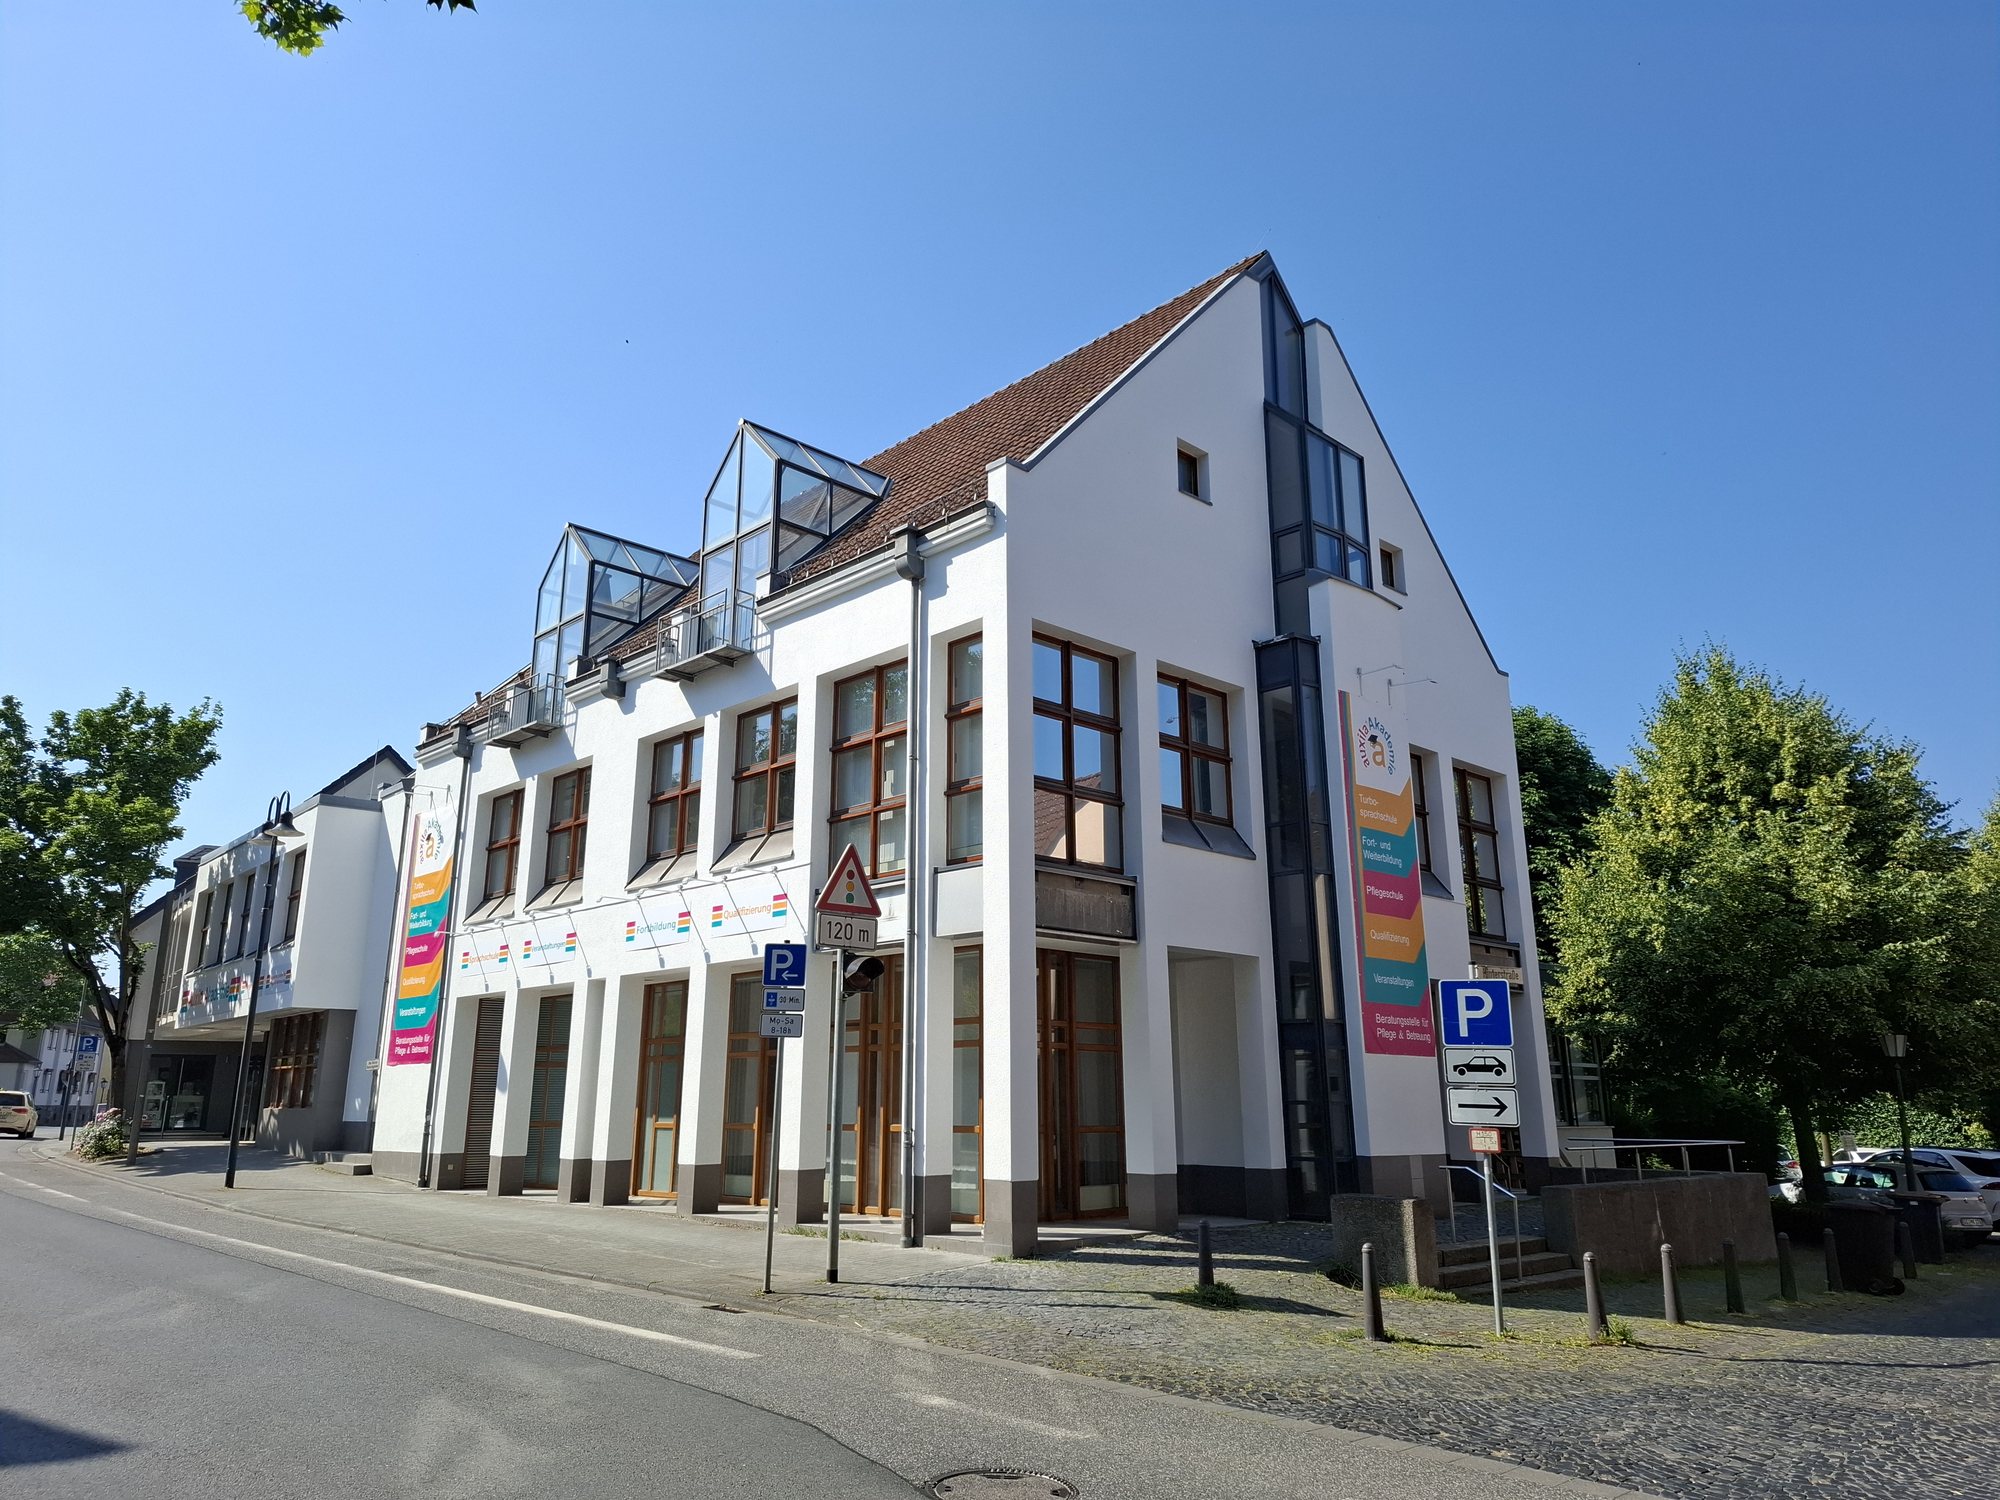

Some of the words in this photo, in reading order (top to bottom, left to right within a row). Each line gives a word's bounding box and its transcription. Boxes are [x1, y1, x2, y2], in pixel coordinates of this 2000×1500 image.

[1359, 794, 1379, 806] Turbo-
[1360, 808, 1398, 824] sprachschule
[1362, 835, 1377, 848] Fort-
[1380, 841, 1391, 851] und
[1363, 849, 1402, 869] Weiterbildung
[1366, 885, 1404, 901] Pflegeschule
[723, 904, 772, 920] Qualifizierung
[636, 921, 677, 935] Fortbildung
[827, 921, 853, 940] 120
[858, 928, 869, 943] m
[1370, 929, 1410, 947] Qualifizierung
[770, 949, 794, 981] P
[1373, 972, 1415, 989] Veranstaltungen
[1375, 1013, 1420, 1028] Beratungsstelle
[1421, 1018, 1429, 1028] für
[1456, 988, 1493, 1037] P
[769, 1016, 795, 1026] Mo-Sa
[770, 1026, 792, 1035] 8-18h
[1376, 1027, 1397, 1041] Pflege
[1398, 1030, 1404, 1039] &
[1405, 1030, 1431, 1044] Betreuung
[82, 1037, 94, 1051] P
